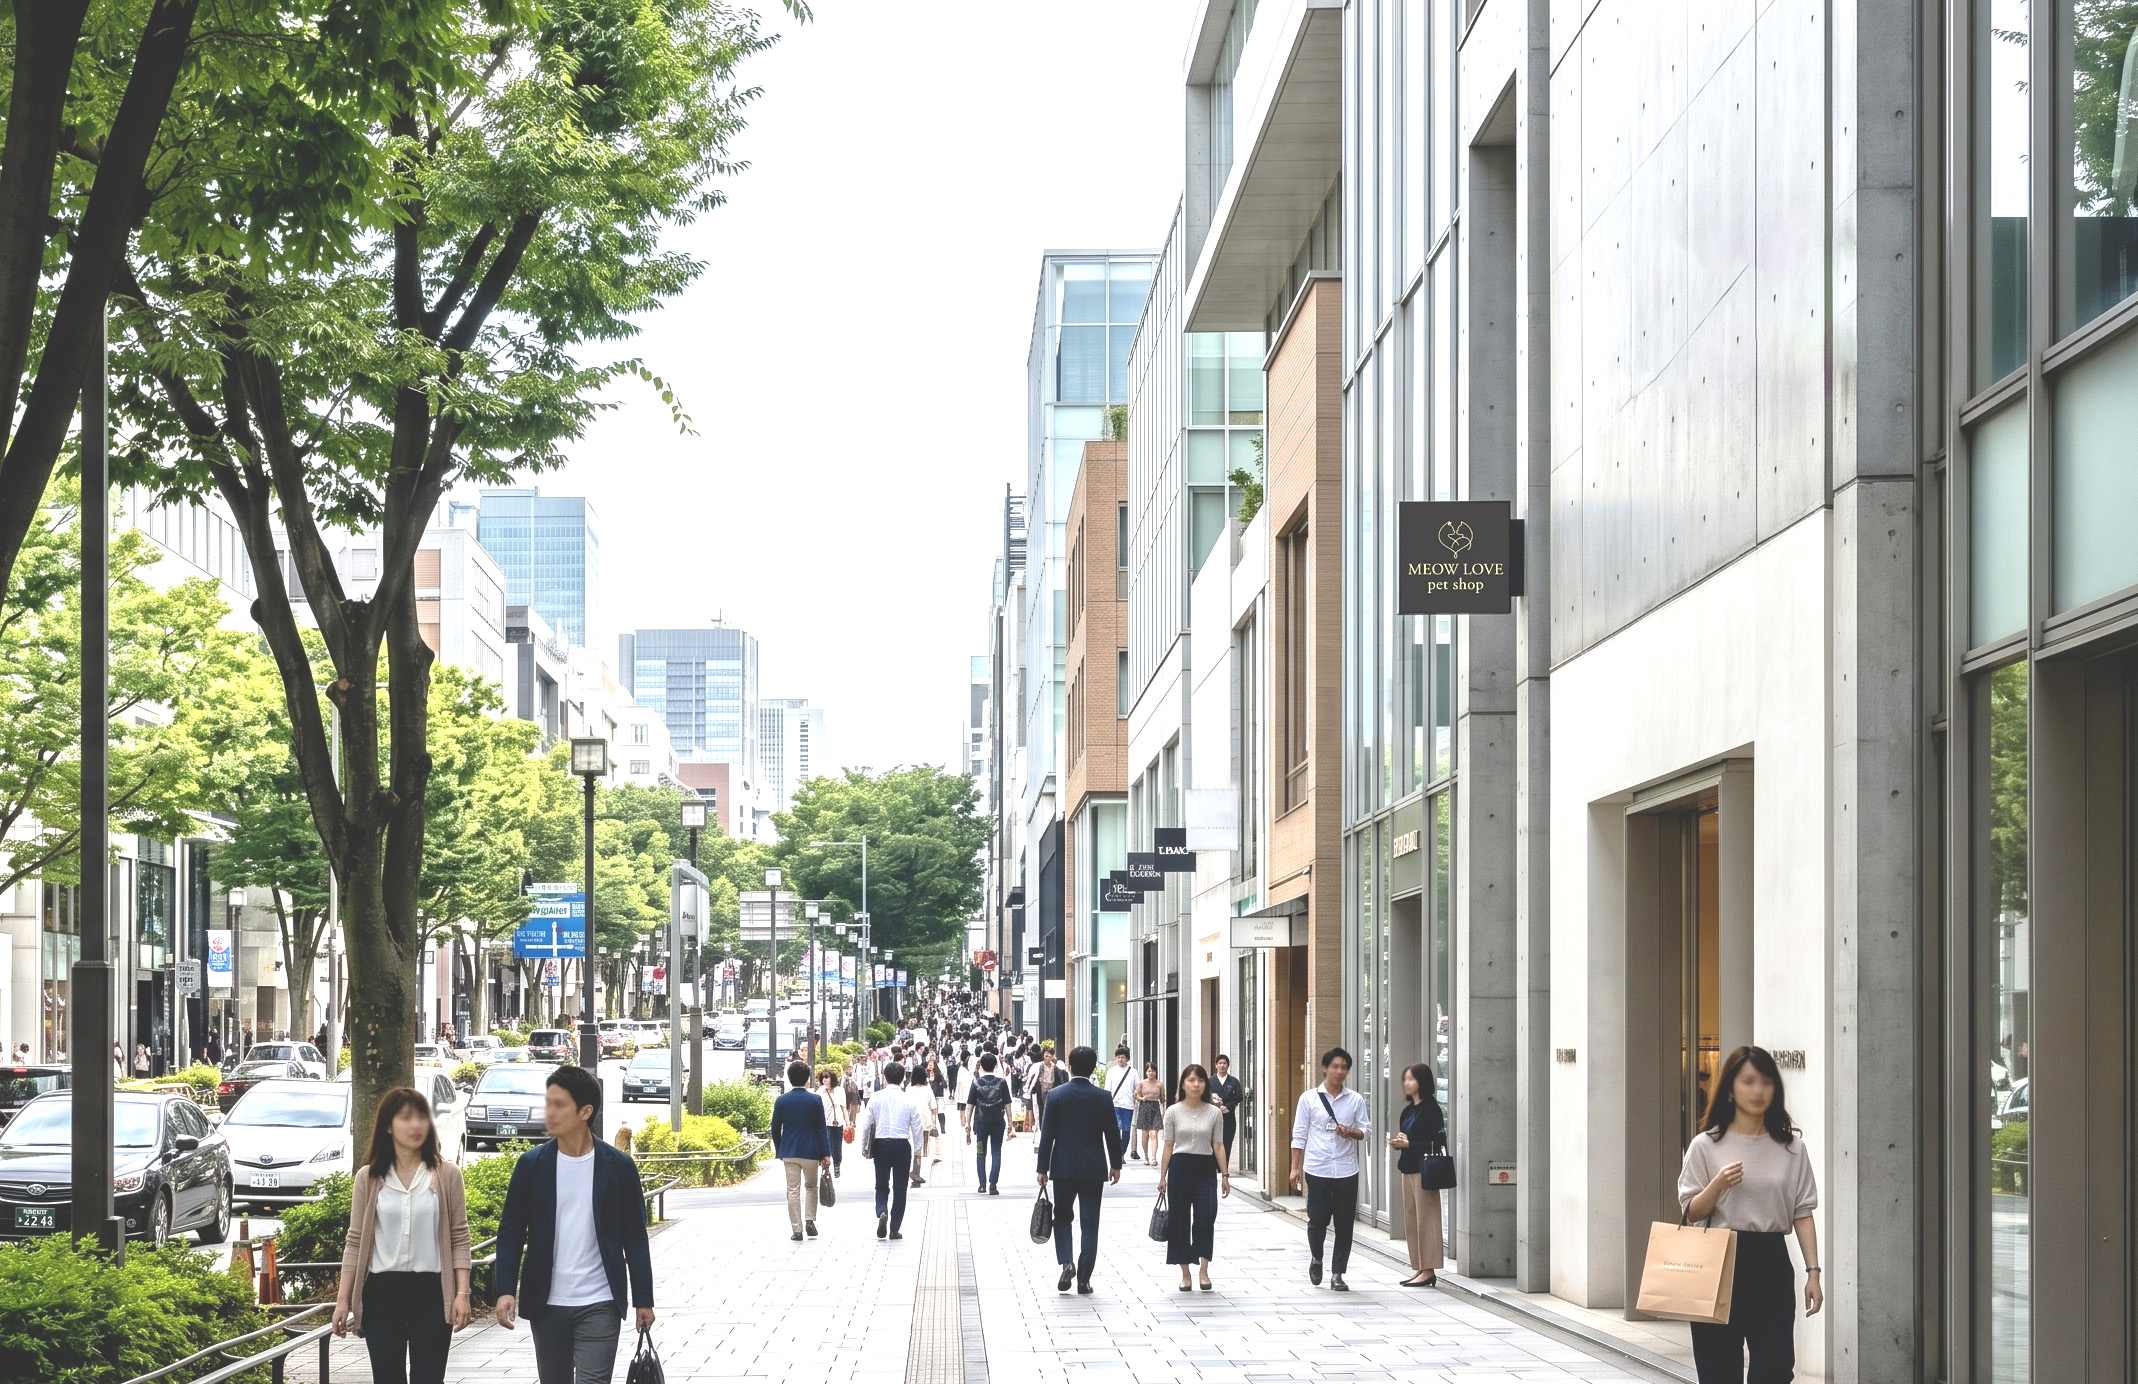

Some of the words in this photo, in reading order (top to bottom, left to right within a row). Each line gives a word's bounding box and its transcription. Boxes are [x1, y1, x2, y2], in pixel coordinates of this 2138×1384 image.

[1409, 563, 1459, 575] MEOW
[1464, 563, 1503, 575] LOVE
[1428, 581, 1448, 593] pet
[1453, 578, 1483, 593] shop
